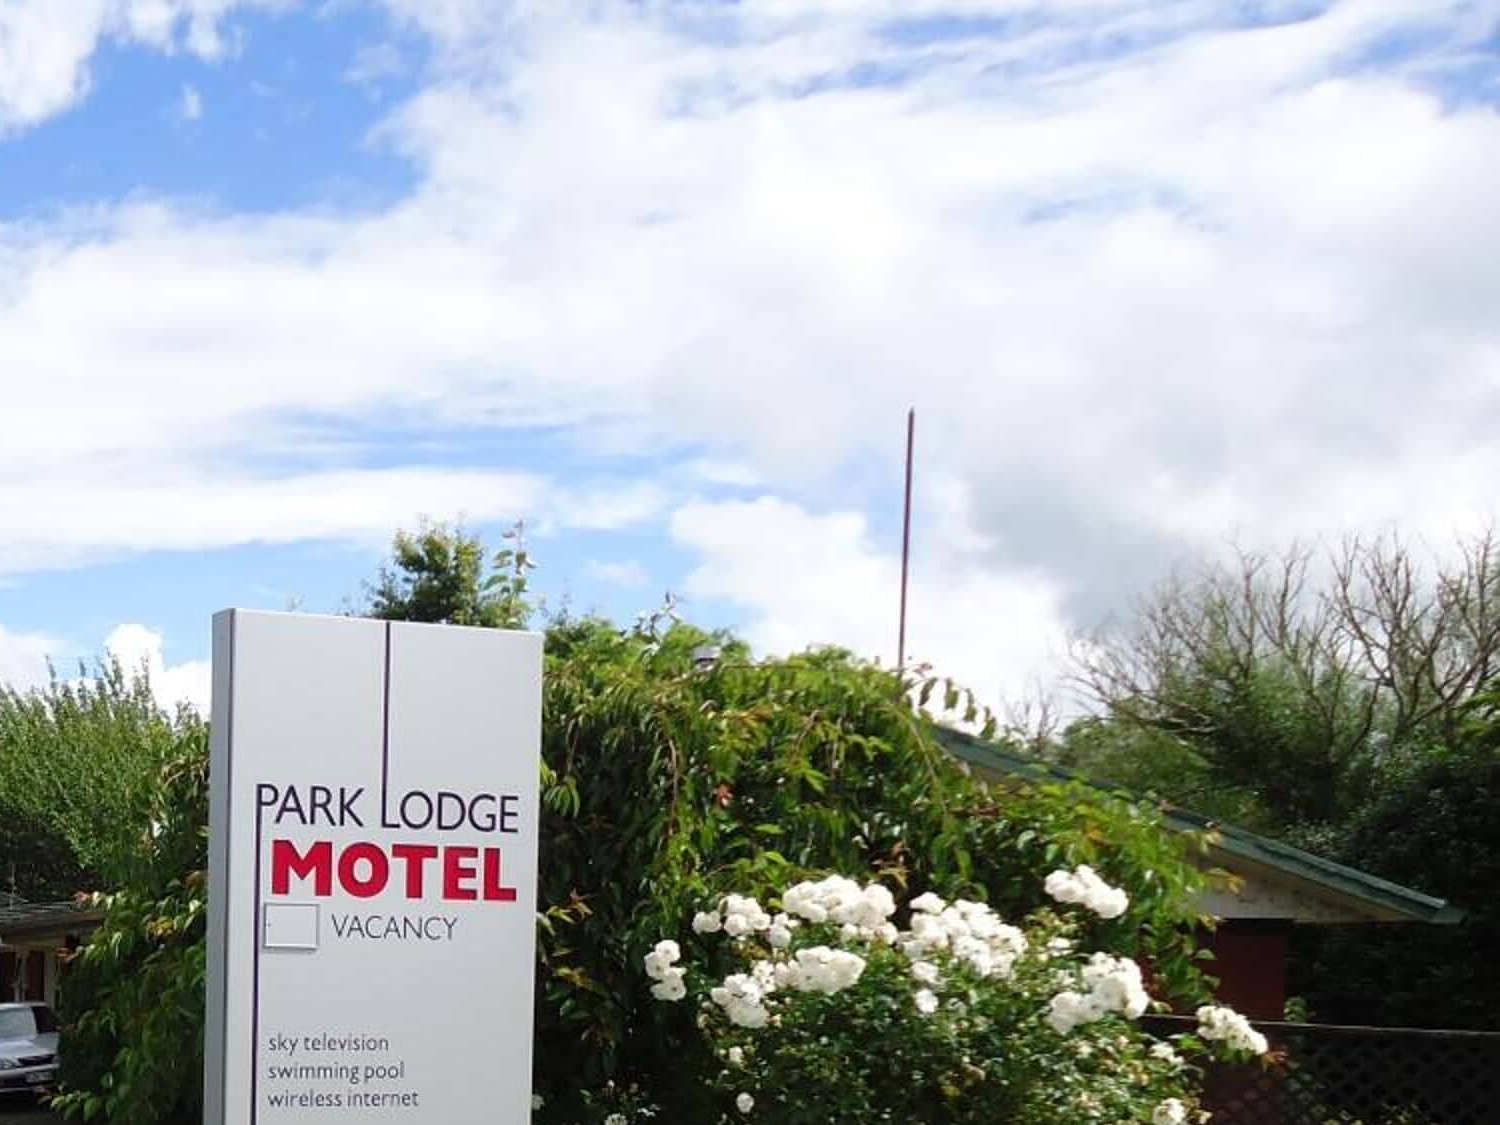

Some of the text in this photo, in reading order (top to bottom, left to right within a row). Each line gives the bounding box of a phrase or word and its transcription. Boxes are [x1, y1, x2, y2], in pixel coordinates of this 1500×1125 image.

[256, 783, 519, 833] PARK LODGE
[271, 839, 518, 902] MOTEL
[331, 913, 459, 940] VACANCY
[268, 1032, 389, 1055] sky television
[268, 1061, 405, 1084] swimming pool
[268, 1088, 419, 1108] wireless internet
